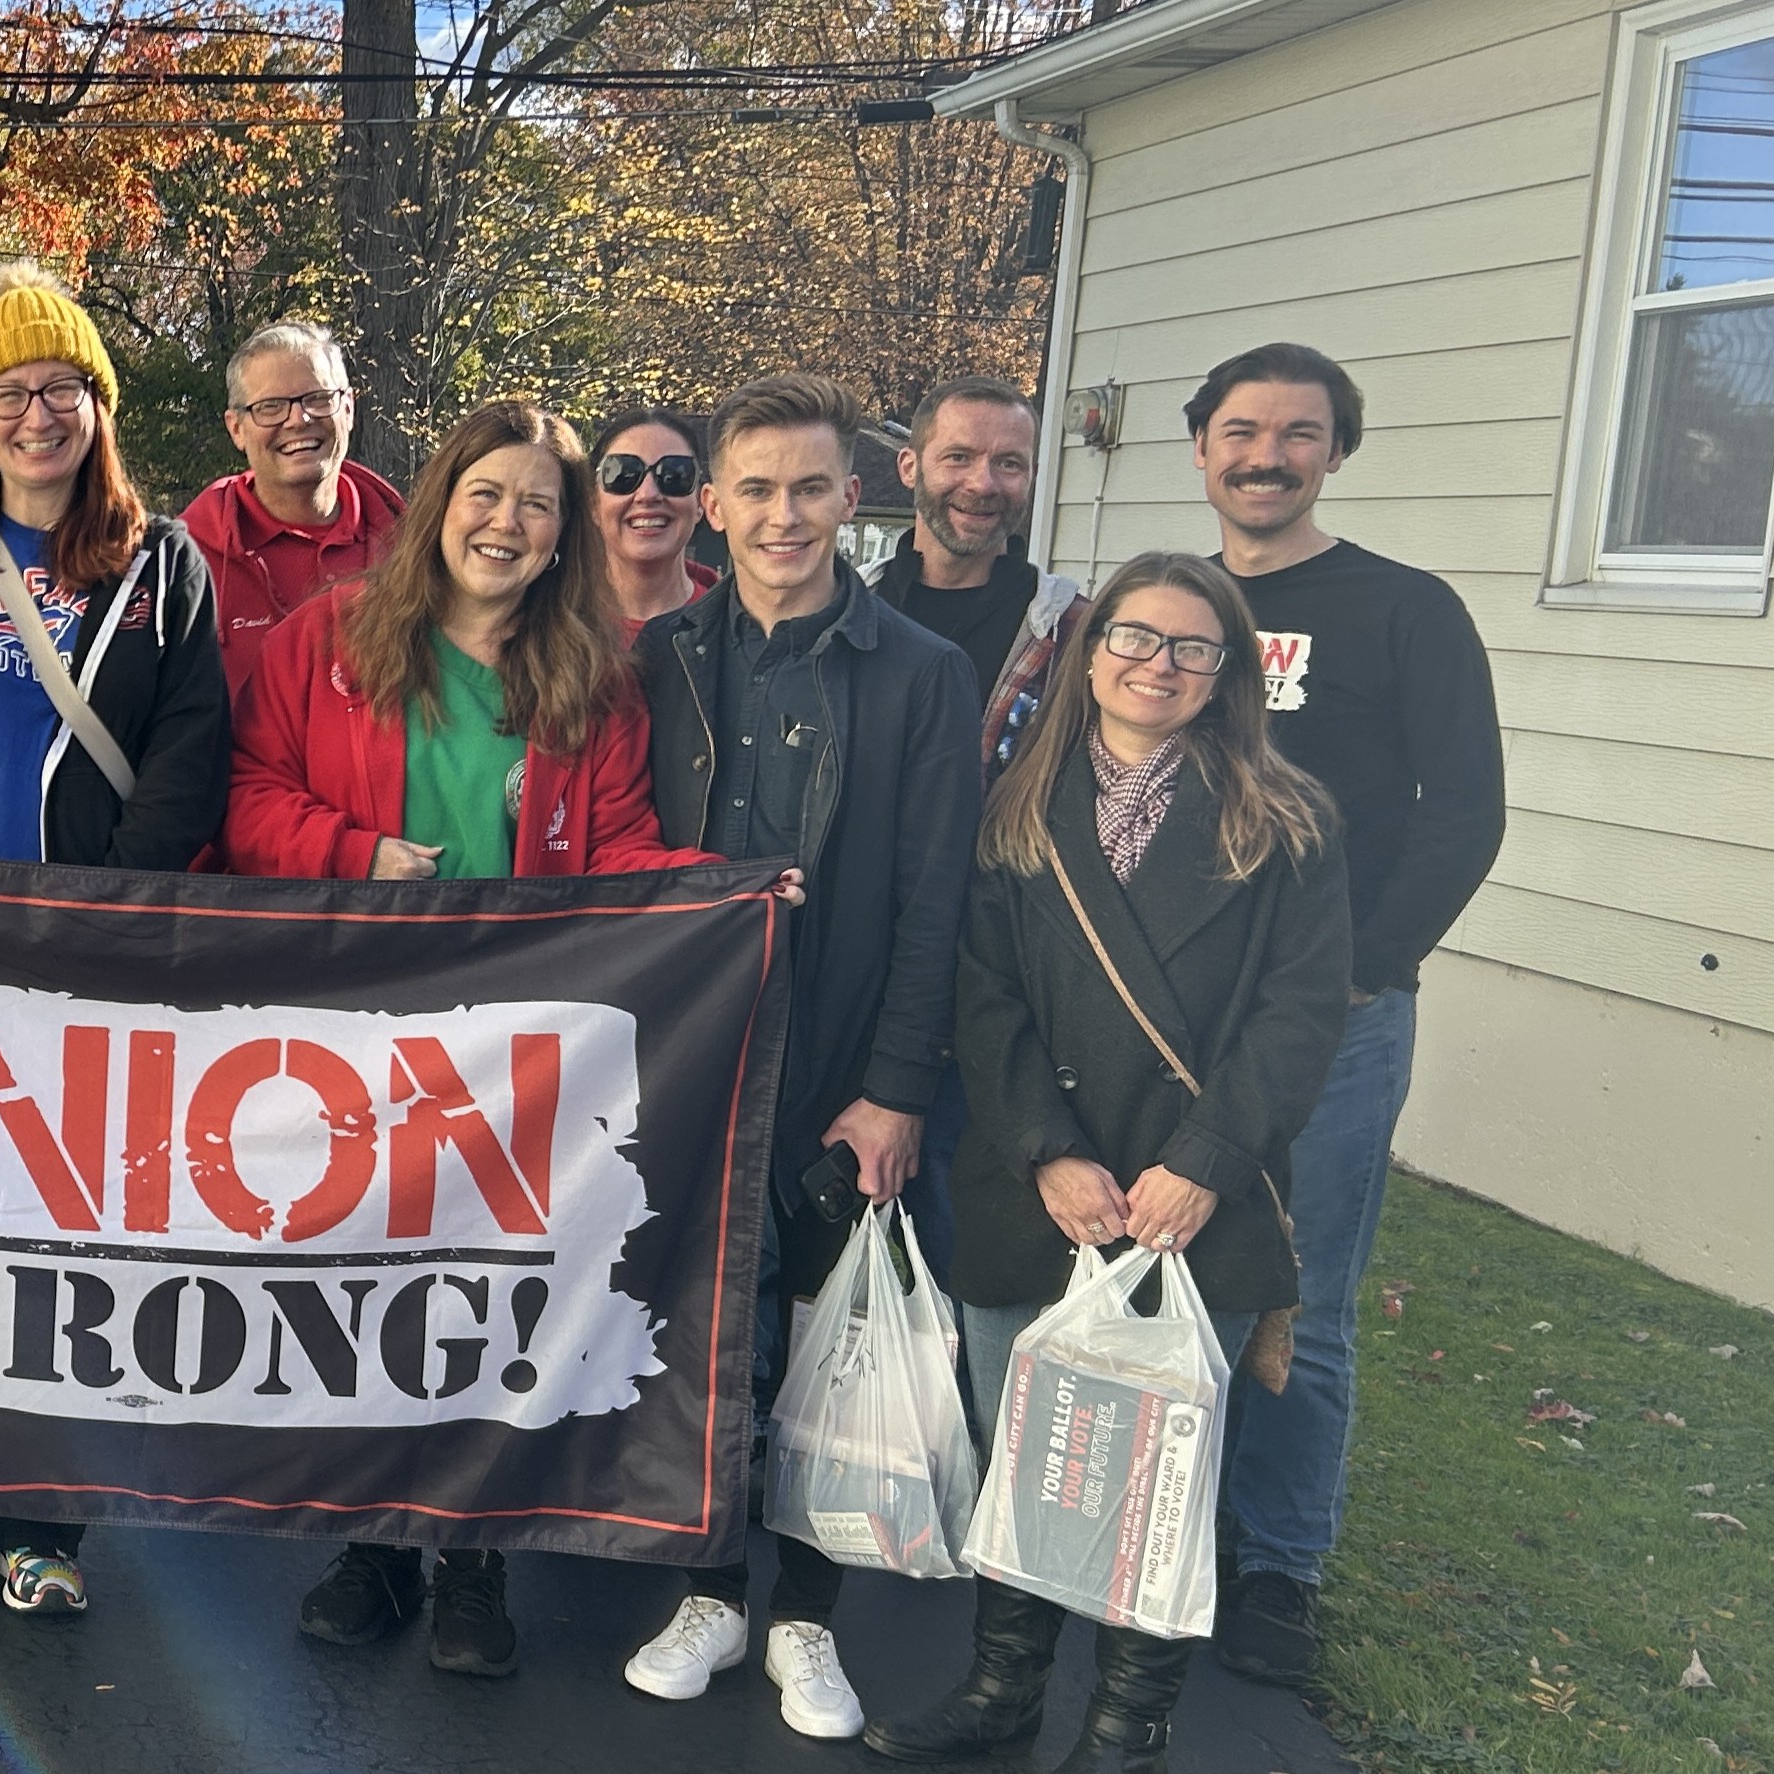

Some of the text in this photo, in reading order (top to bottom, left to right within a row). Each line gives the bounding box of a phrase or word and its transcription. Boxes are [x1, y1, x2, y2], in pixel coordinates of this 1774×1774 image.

[231, 615, 273, 630] David
[547, 840, 570, 851] 1122
[1008, 1421, 1020, 1449] CITY
[1013, 1395, 1025, 1420] CAN
[1040, 1373, 1077, 1504] YOUR BALLOT.
[1060, 1402, 1093, 1510] YOUR VOTE.
[1081, 1398, 1117, 1518] OUR FUTURE.
[1146, 1445, 1177, 1586] FIND OUT YOUR WARD &
[1161, 1470, 1186, 1566] WHERE TO VOTE!
